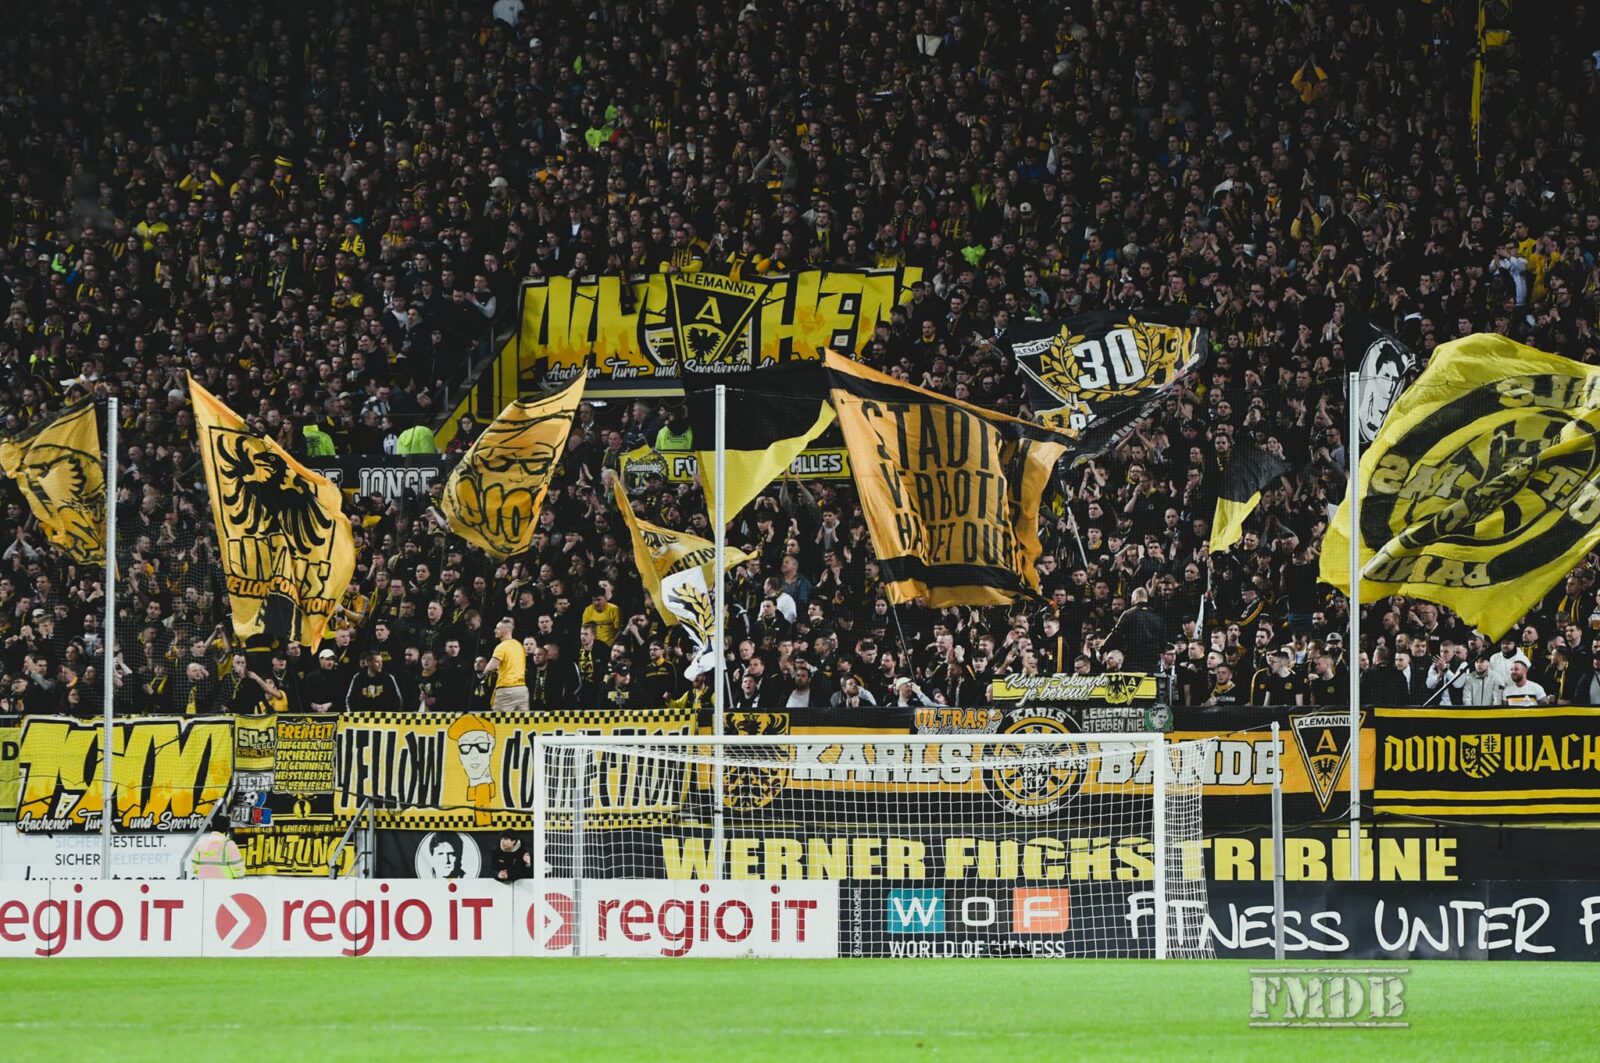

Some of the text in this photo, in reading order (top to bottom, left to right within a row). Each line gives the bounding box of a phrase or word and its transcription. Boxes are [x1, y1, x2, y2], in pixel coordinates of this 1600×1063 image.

[676, 272, 757, 297] ALEMANNIA
[695, 296, 721, 324] A
[605, 358, 648, 381] Turn-
[654, 361, 677, 378] und
[1072, 328, 1146, 389] 30
[791, 454, 842, 473] ALLES
[914, 708, 988, 729] ULTRAS
[1012, 707, 1067, 724] KARLS
[1083, 719, 1124, 732] STERBEN
[1297, 715, 1354, 727] ALEMANNI
[278, 723, 334, 739] FREIHEIT
[1316, 729, 1338, 752] A
[276, 751, 333, 761] SICHERHEIT
[792, 738, 974, 783] KARLS
[1384, 734, 1460, 773] DOM
[333, 729, 443, 807] YELLOW
[17, 813, 72, 831] Aachener
[130, 815, 153, 829] und
[55, 854, 101, 866] SICHER
[247, 835, 345, 867] HALTUNG
[662, 838, 926, 880] WERNER
[945, 838, 1156, 880] FUCHS
[0, 884, 184, 957] egio iT
[284, 884, 493, 957] regio iT
[598, 884, 817, 957] regio iT
[1126, 891, 1349, 953] FTNESS
[1375, 897, 1556, 953] UNTER
[889, 941, 954, 958] WORLD
[962, 941, 984, 958] OF
